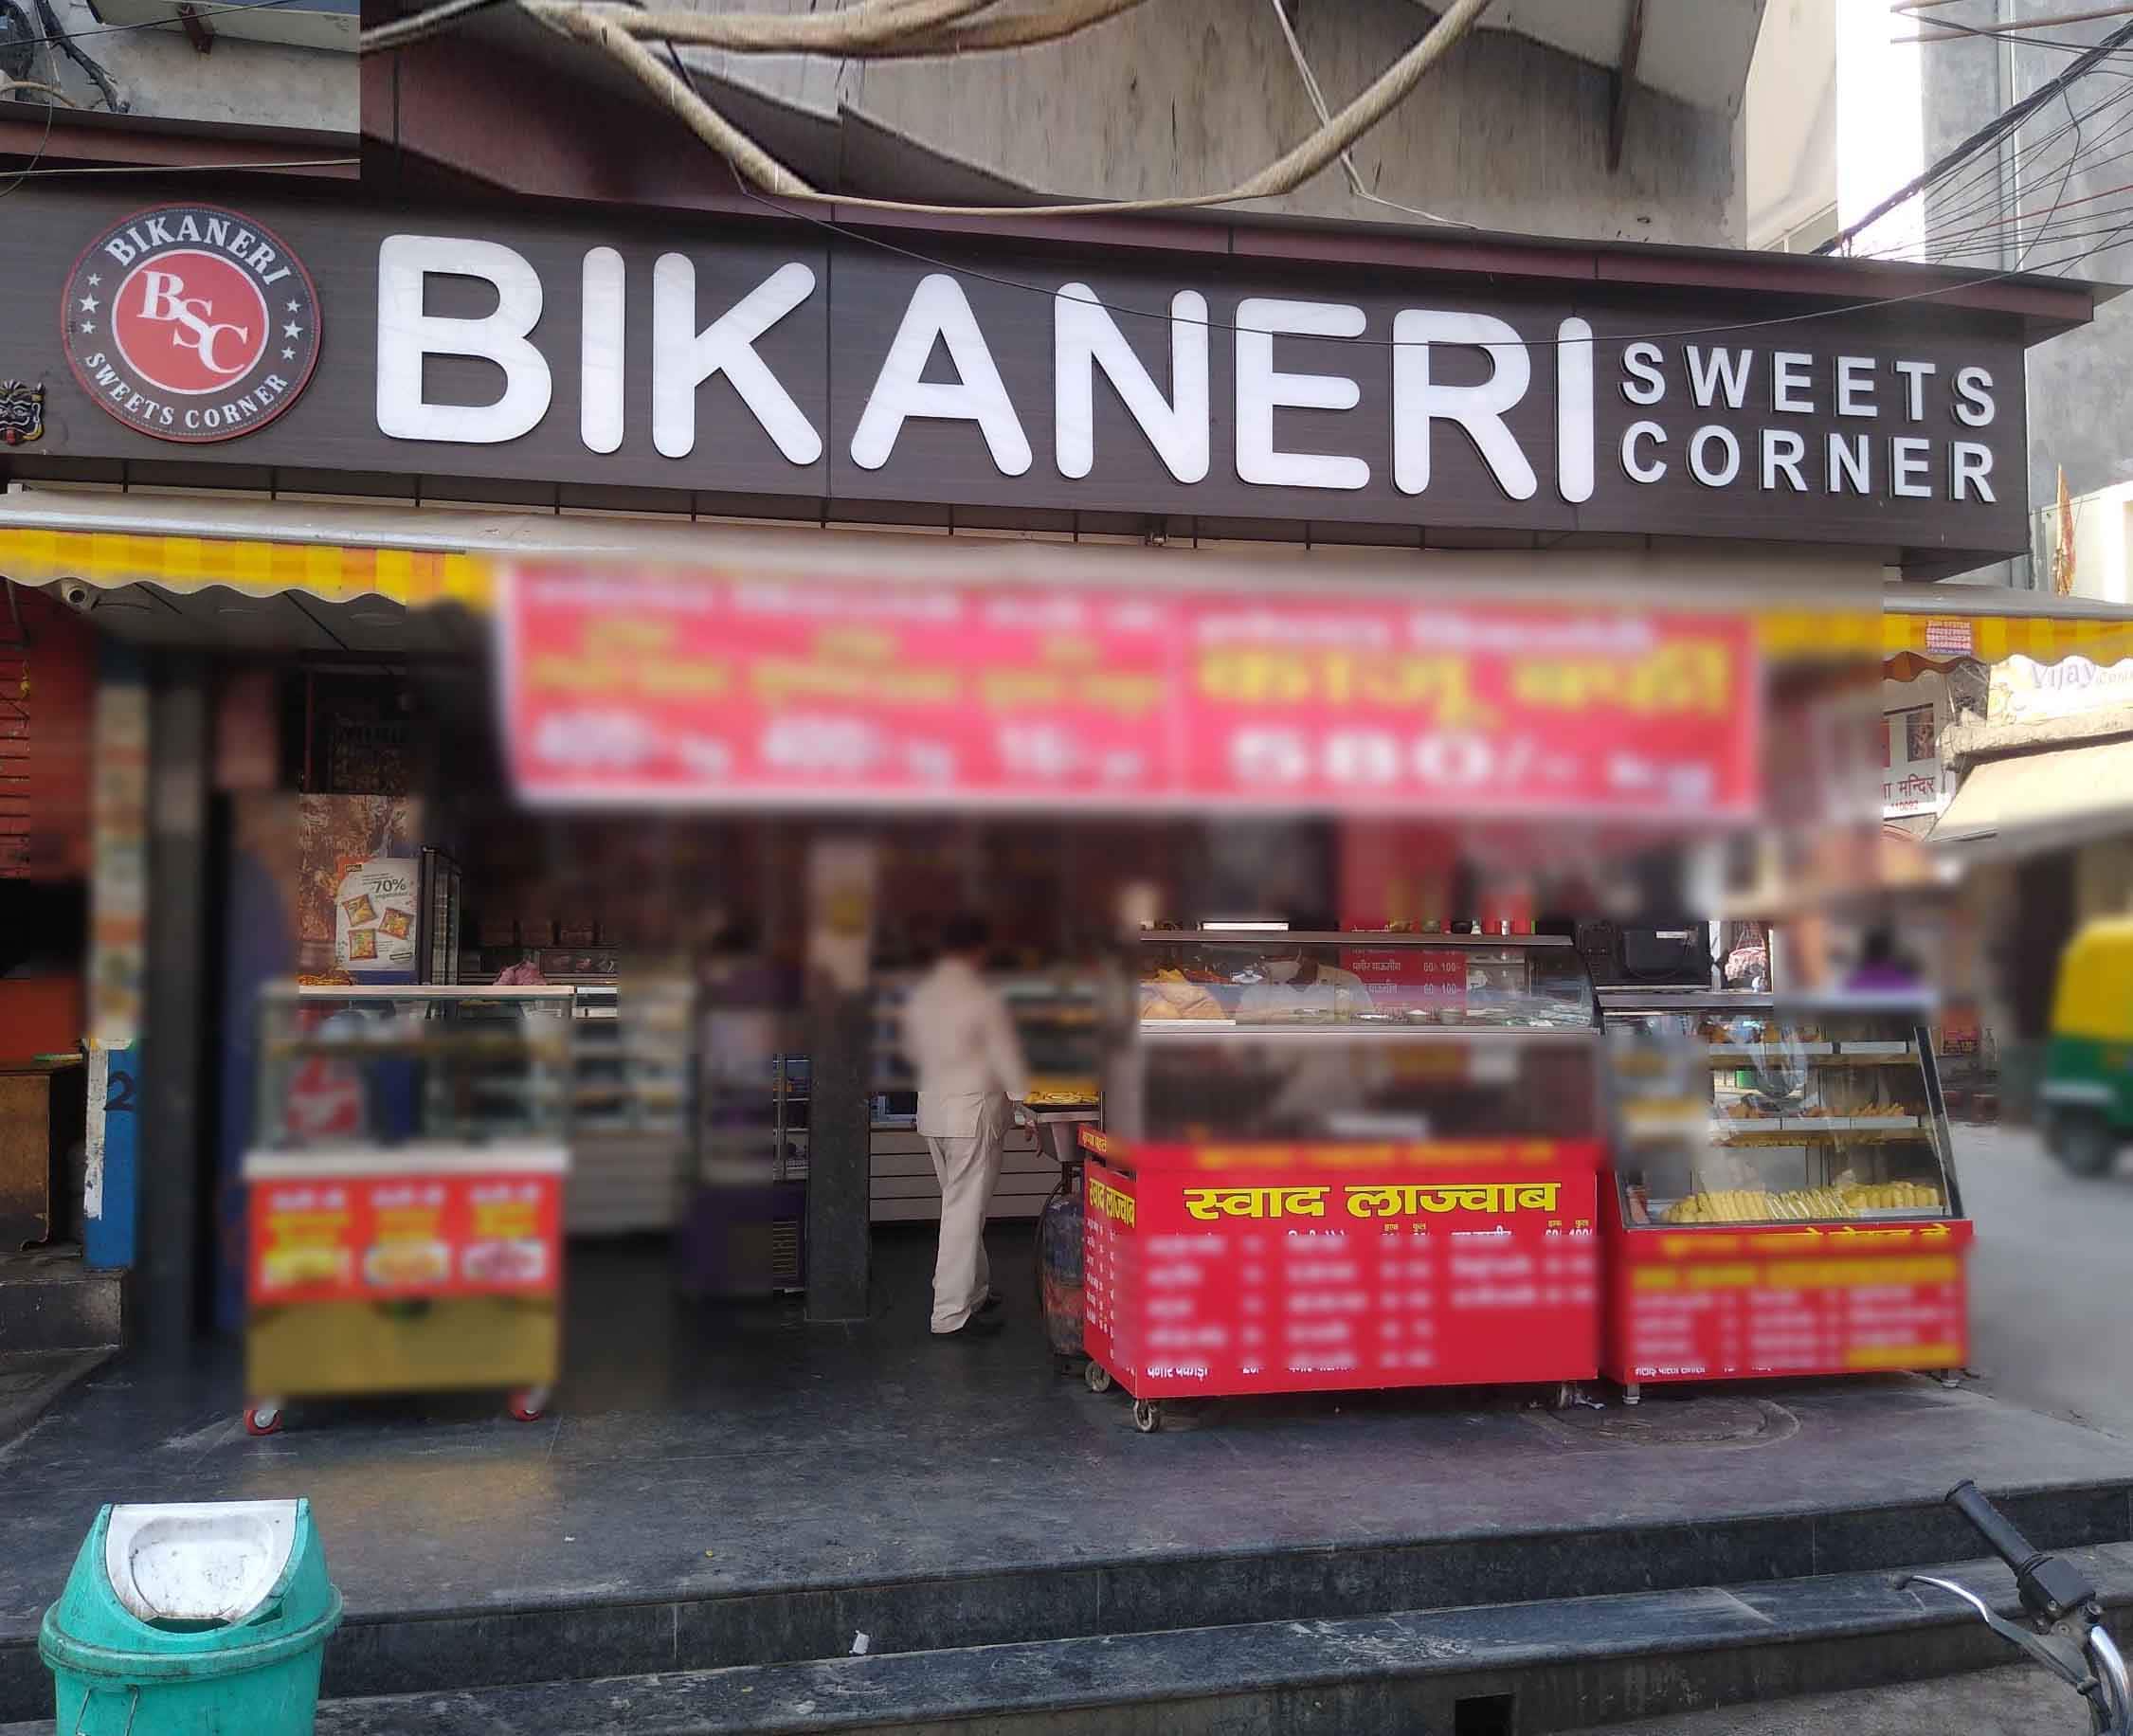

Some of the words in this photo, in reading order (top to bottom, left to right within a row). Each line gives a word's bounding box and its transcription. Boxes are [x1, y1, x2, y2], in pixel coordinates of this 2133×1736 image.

[104, 215, 293, 286] BIKANERI
[136, 269, 248, 375] BSC
[85, 351, 174, 427] SWEETS
[185, 372, 288, 428] CORNER
[376, 234, 1595, 503] BIKANERI
[1620, 341, 1996, 427] SWEETS
[1620, 420, 1997, 503] CORNER
[373, 877, 407, 894] 70%
[1184, 1186, 1330, 1221] स्वाद
[1344, 1182, 1562, 1219] लाज्वाब
